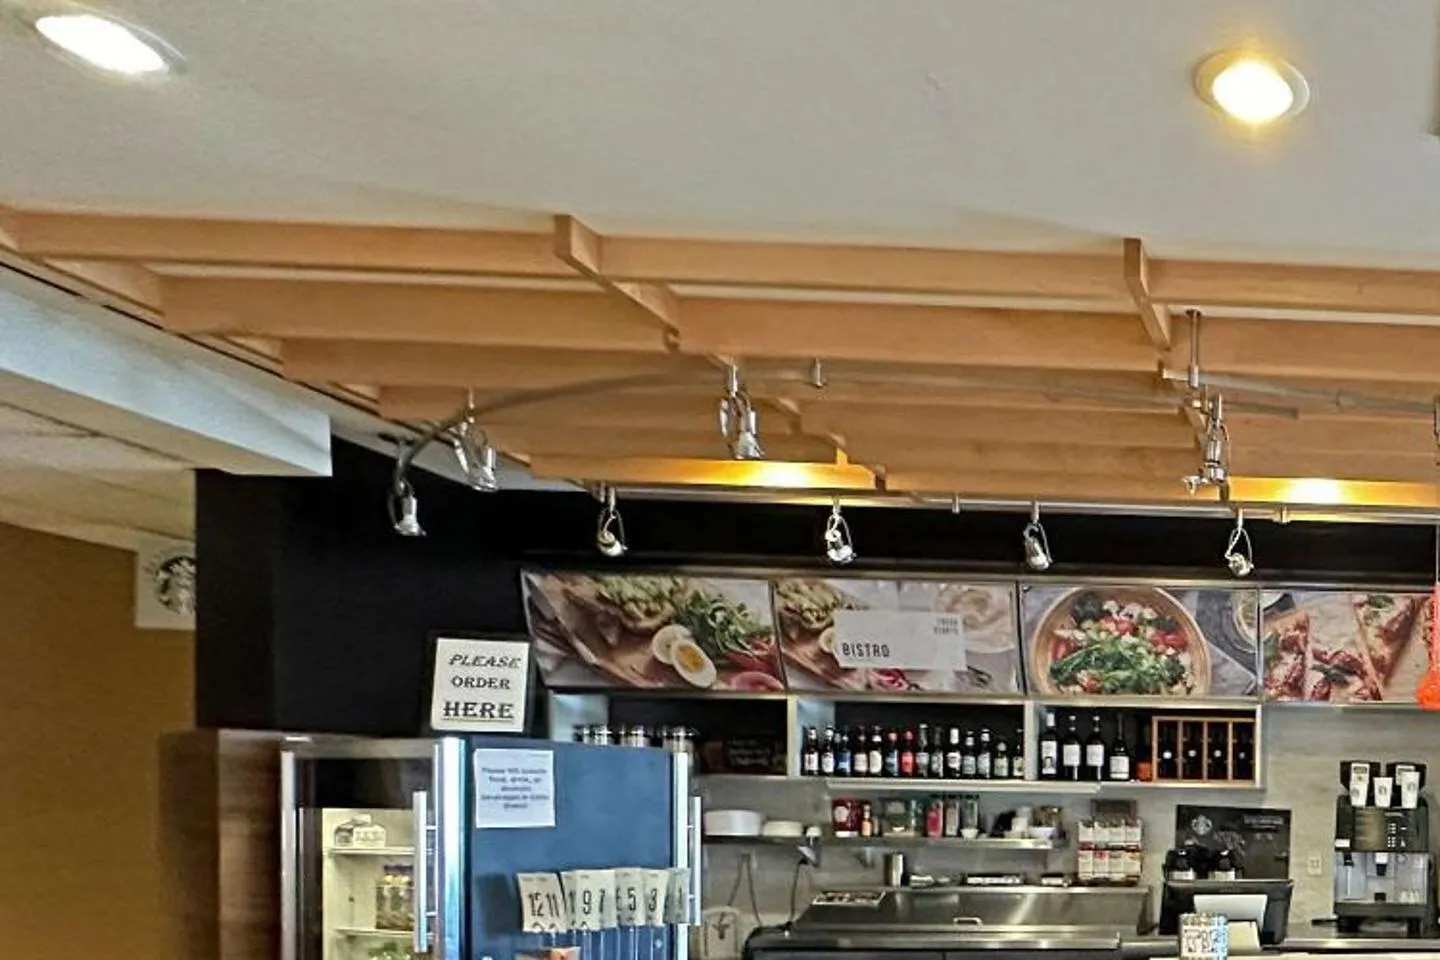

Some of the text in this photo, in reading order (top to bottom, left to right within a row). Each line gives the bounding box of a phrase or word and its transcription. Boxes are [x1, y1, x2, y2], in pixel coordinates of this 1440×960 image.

[448, 654, 521, 669] PLEASE
[841, 642, 890, 657] BISTRO
[451, 675, 511, 690] ORDER
[443, 701, 515, 719] HERE
[528, 892, 545, 917] 12
[545, 892, 560, 918] 11
[582, 889, 591, 914] 9
[627, 886, 636, 911] 5
[648, 887, 658, 912] 3
